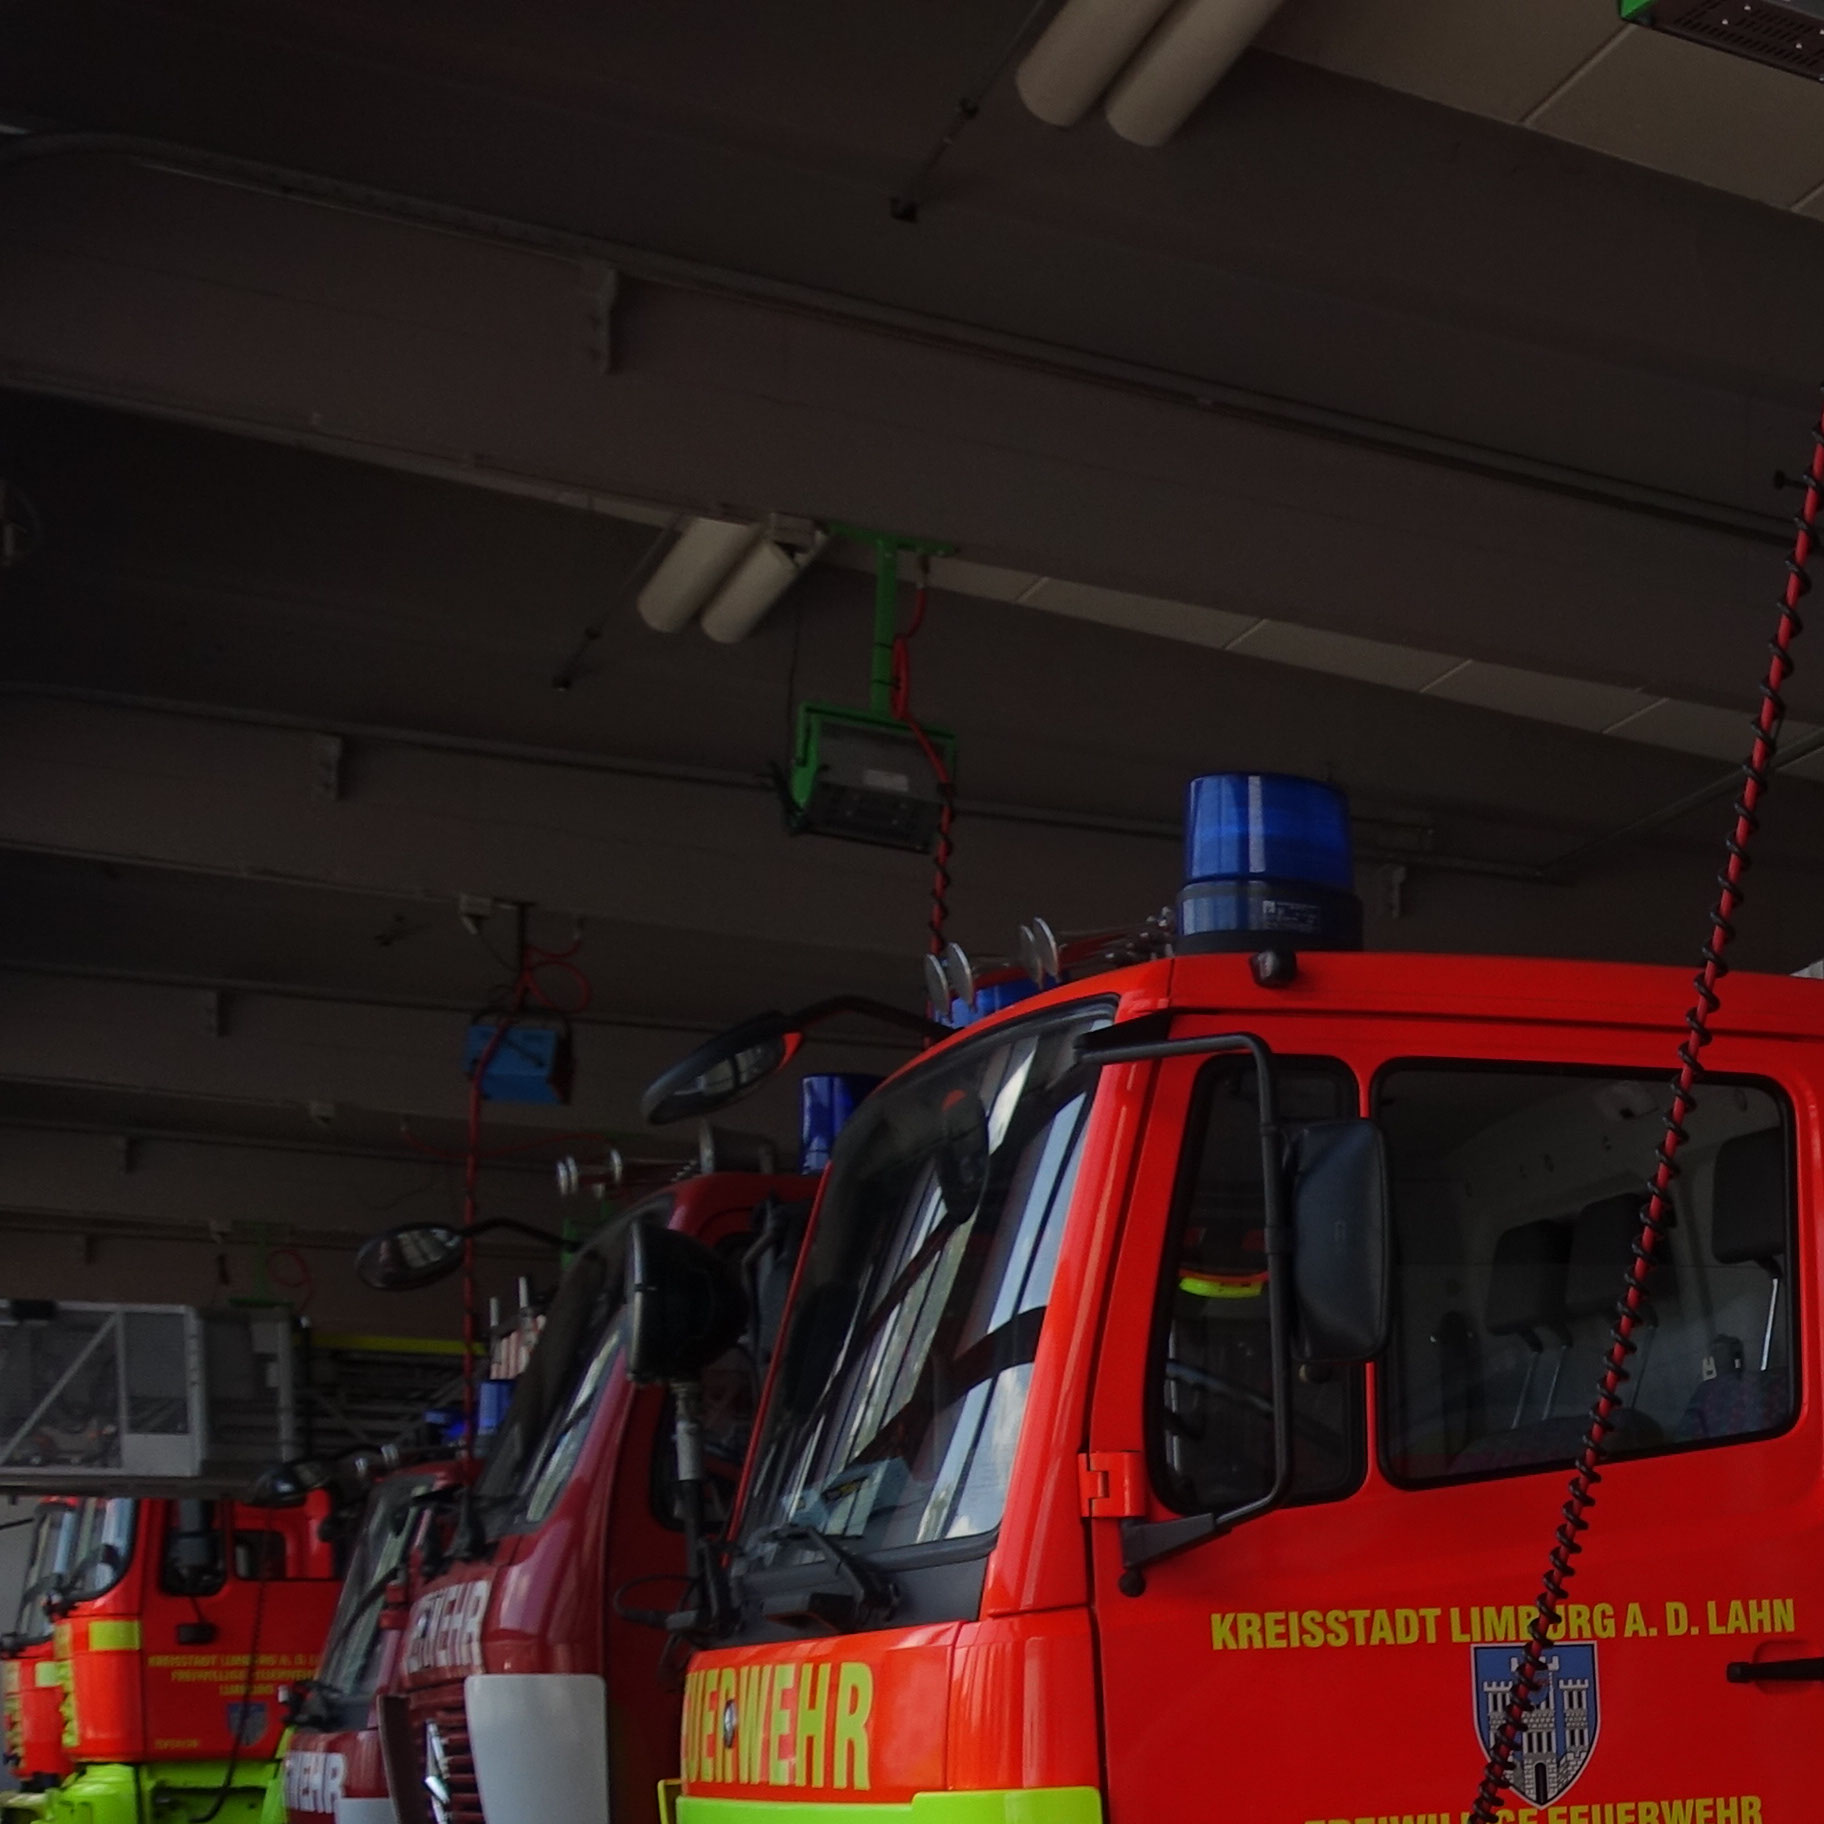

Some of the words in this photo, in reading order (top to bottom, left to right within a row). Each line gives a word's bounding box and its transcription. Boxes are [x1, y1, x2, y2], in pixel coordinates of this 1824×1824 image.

[1210, 1605, 1442, 1650] KREISSTADT
[1624, 1602, 1659, 1637] A.
[1665, 1601, 1699, 1637] D.
[1707, 1599, 1795, 1635] LAHN
